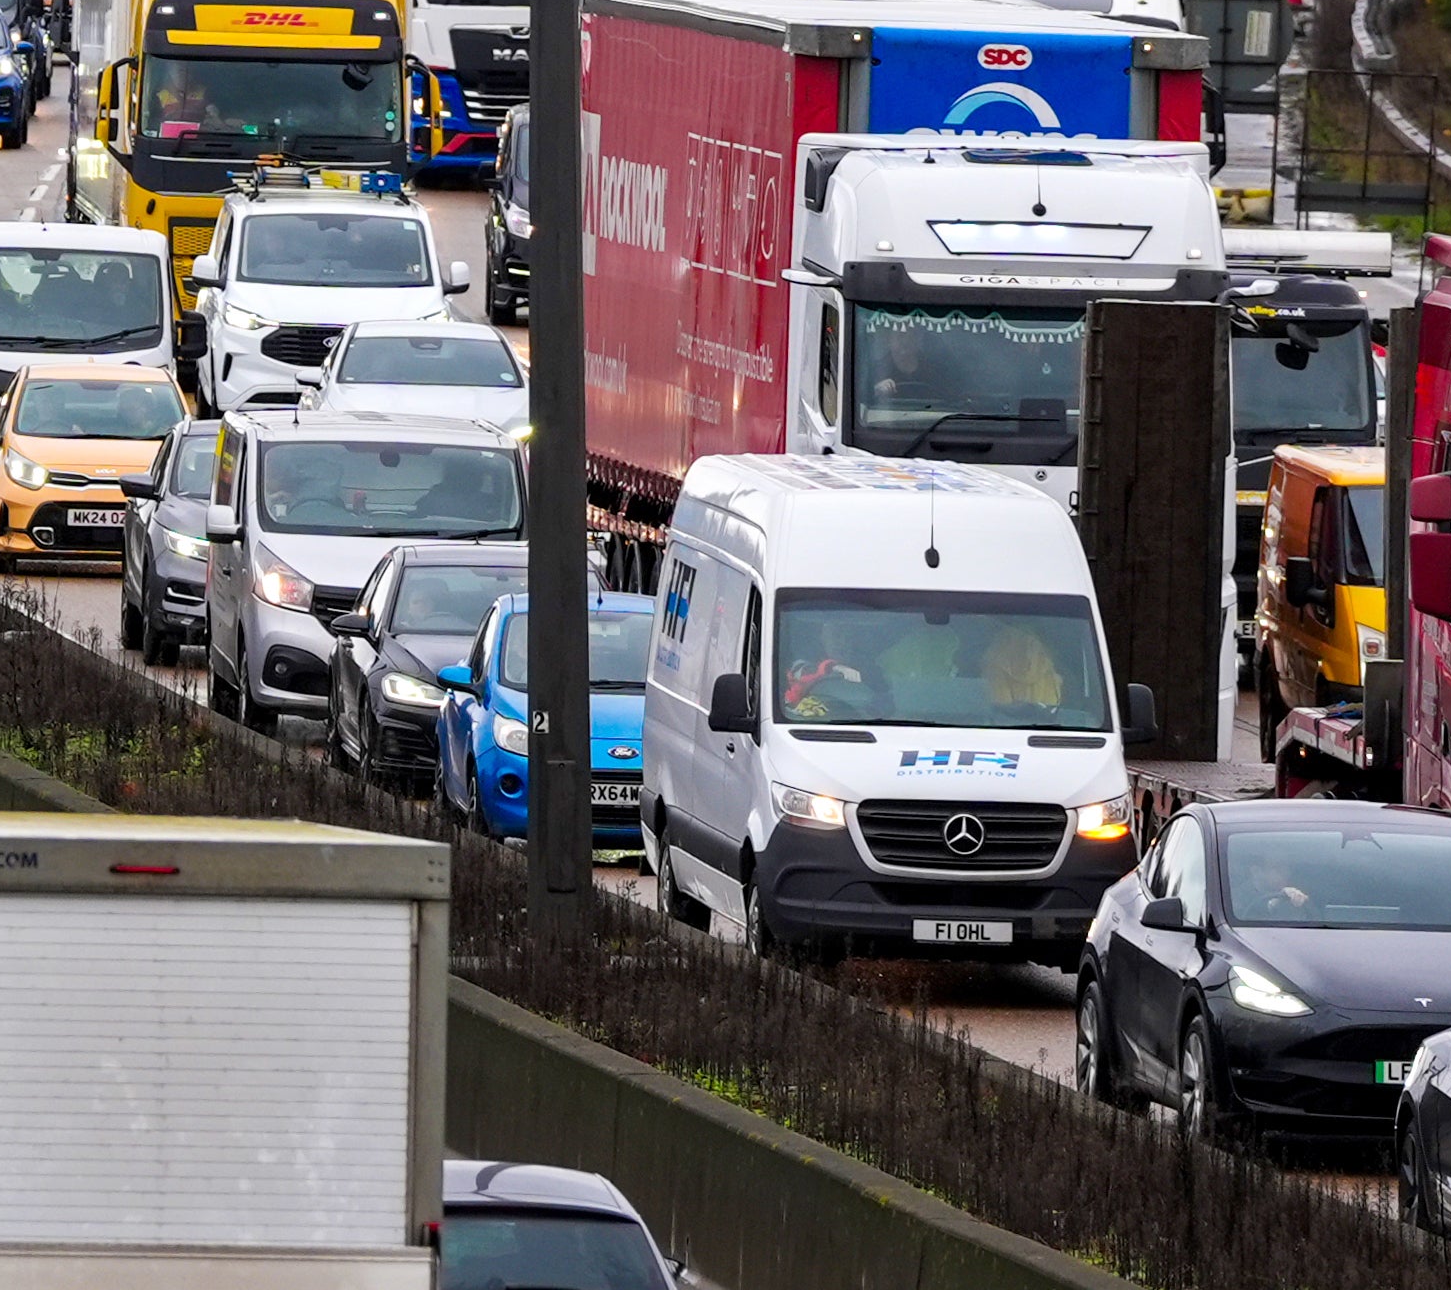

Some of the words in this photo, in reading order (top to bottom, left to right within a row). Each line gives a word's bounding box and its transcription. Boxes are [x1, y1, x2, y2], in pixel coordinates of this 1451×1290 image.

[243, 12, 307, 27] DHL
[492, 49, 530, 61] MA
[983, 48, 1027, 66] SDC
[600, 154, 668, 252] ROCKWOOL
[73, 511, 107, 525] MK24
[534, 711, 546, 732] 2
[896, 768, 1017, 779] DISTRIBUTION
[590, 785, 629, 801] RX64
[956, 923, 991, 941] OHL
[1388, 1062, 1412, 1081] LF
